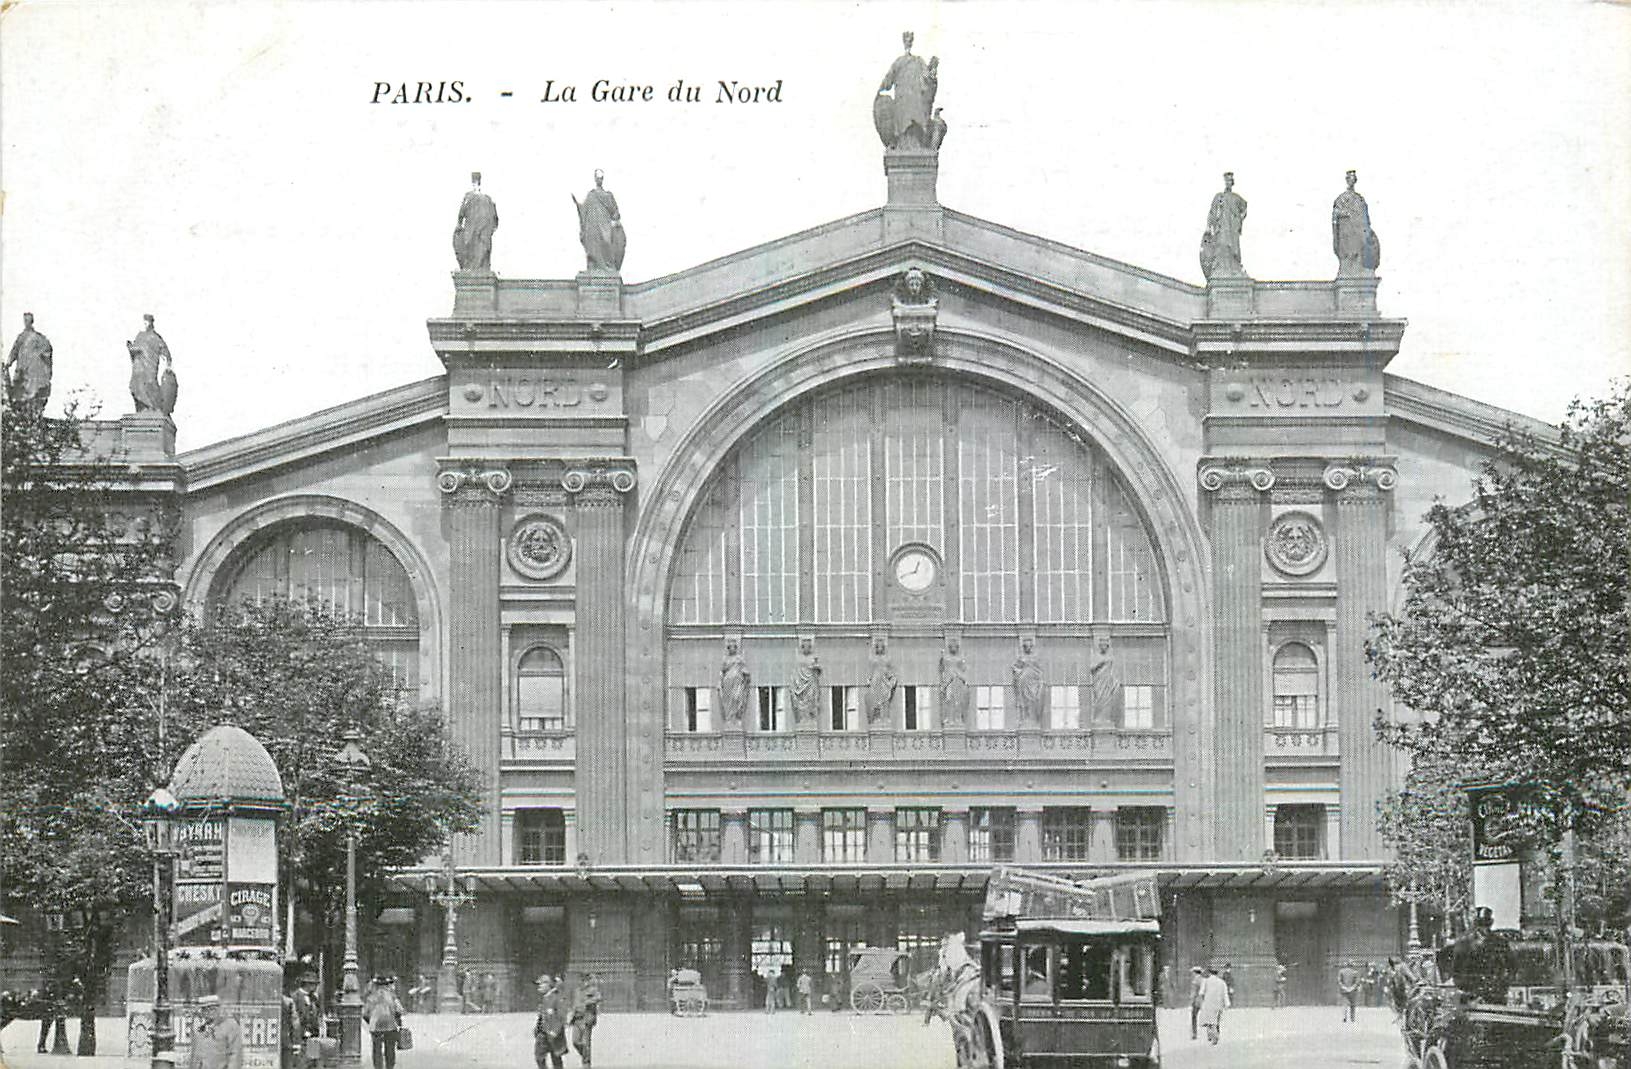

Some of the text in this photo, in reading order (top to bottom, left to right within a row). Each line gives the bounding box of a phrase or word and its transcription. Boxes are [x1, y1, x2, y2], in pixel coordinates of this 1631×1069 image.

[488, 378, 582, 408] NORD
[1249, 378, 1343, 408] NORD
[230, 889, 270, 908] CIRAGE
